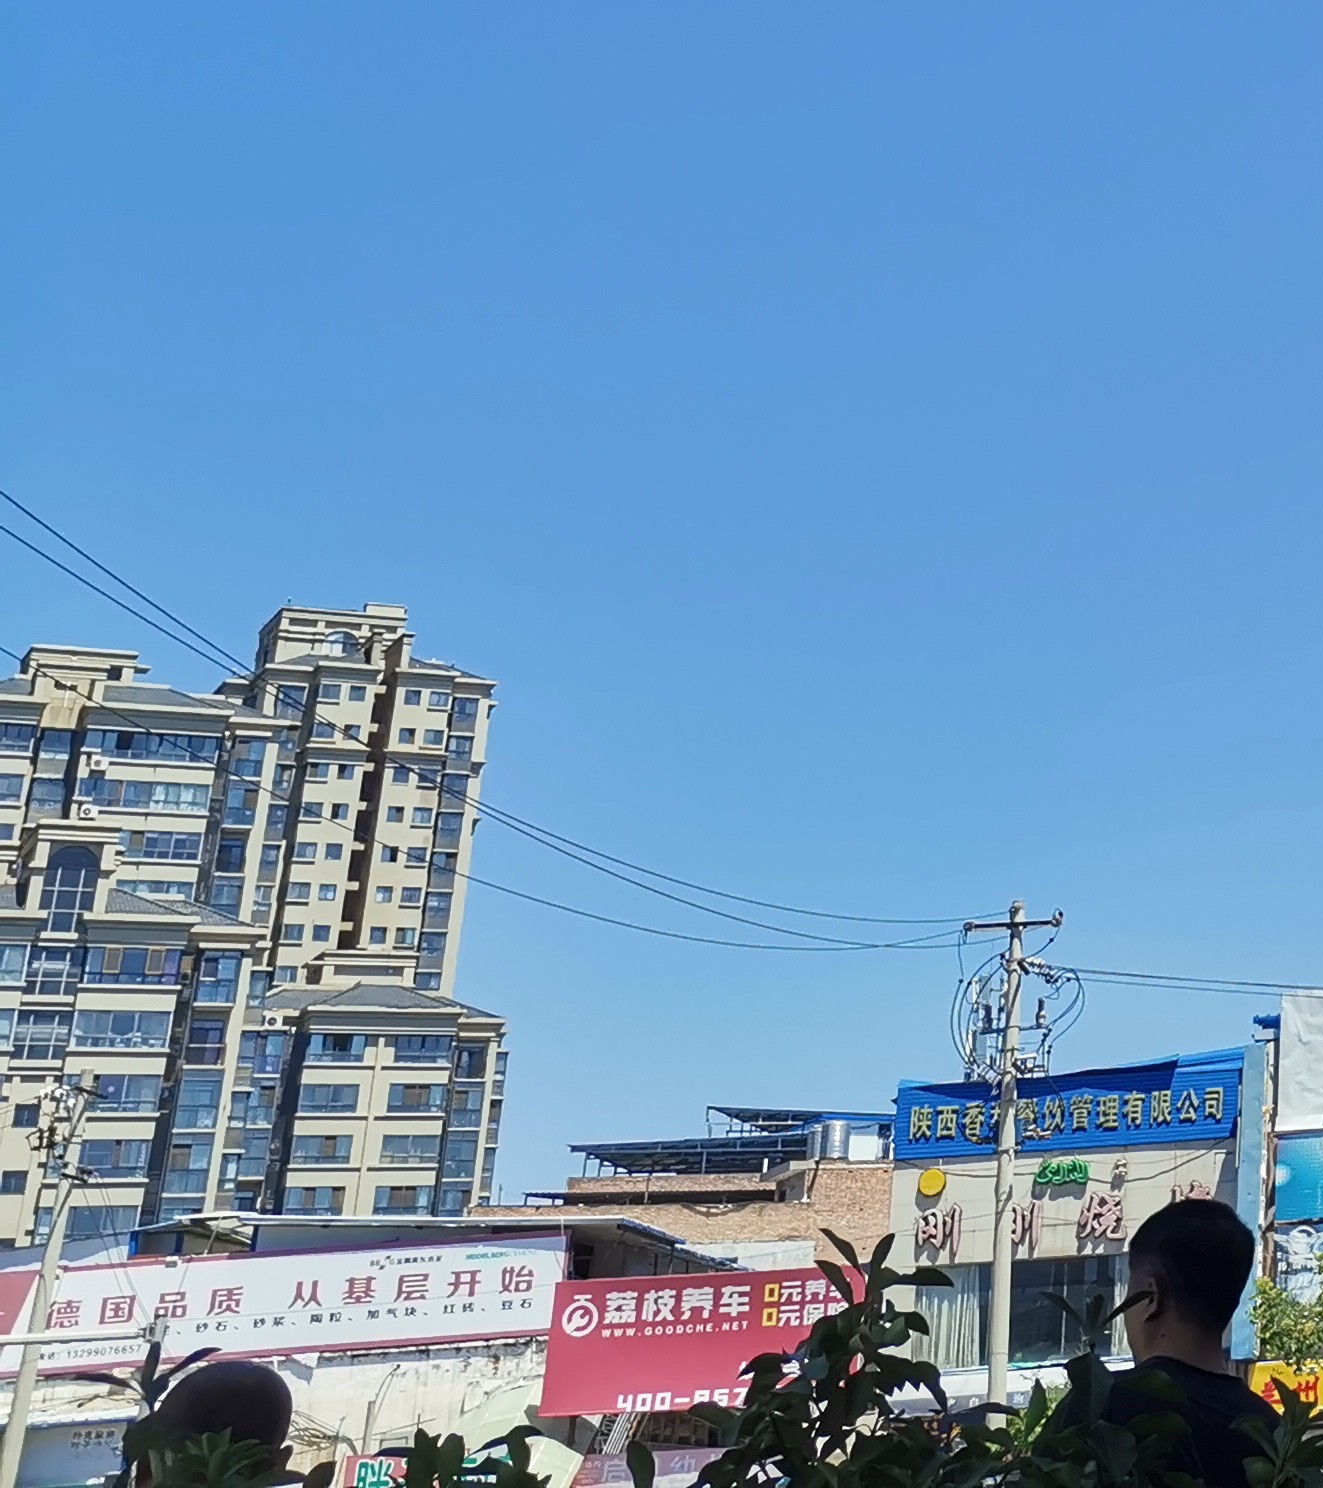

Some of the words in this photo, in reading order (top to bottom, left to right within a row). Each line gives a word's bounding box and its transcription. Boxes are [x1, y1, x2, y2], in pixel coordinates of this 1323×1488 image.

[909, 1087, 1225, 1140] 陕西香餐饮管理有限公司
[46, 1286, 244, 1330] 德国品质
[288, 1264, 535, 1310] 从基层开始
[602, 1285, 751, 1324] 荔枝养车
[601, 1320, 749, 1338] WWW.GOODCHE.NET
